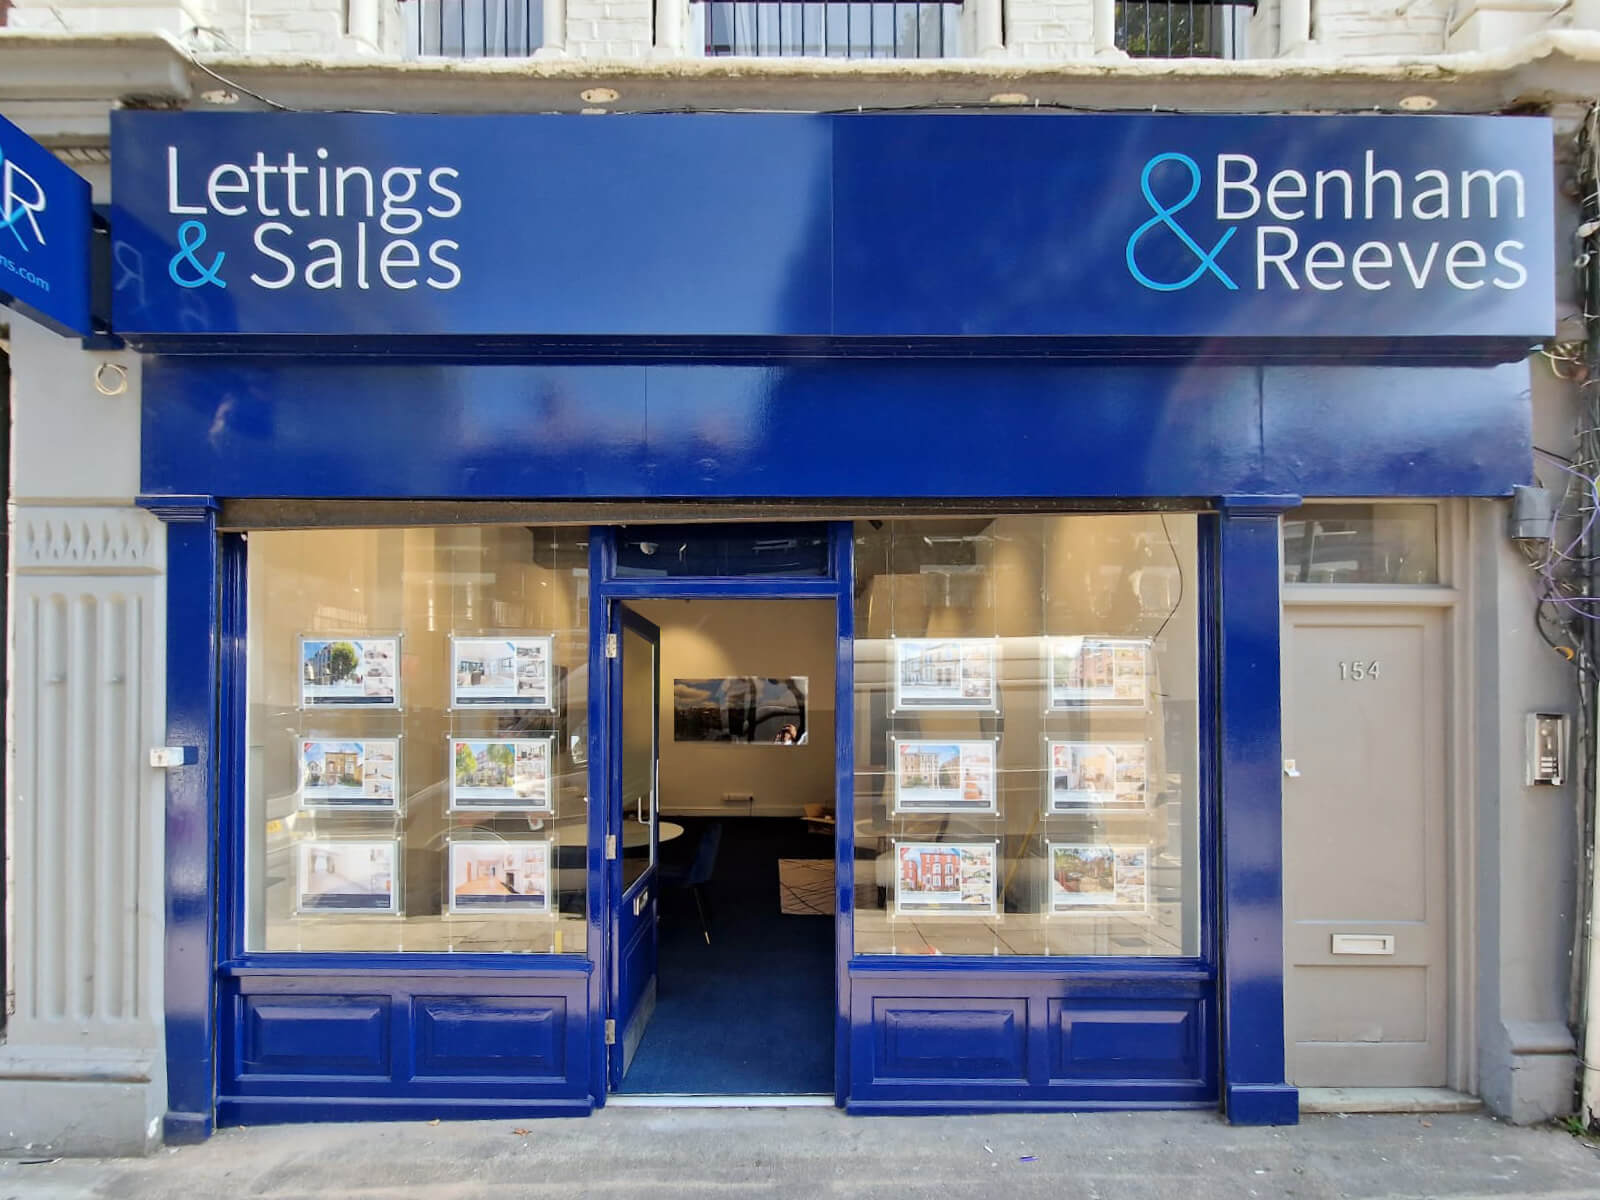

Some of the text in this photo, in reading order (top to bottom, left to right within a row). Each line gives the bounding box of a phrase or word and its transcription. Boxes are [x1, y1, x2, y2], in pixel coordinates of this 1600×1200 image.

[168, 145, 462, 235] Lettings
[1216, 149, 1526, 220] Benham
[168, 220, 462, 290] & Sales
[1125, 151, 1528, 291] & Reeves
[1339, 660, 1381, 681] 154
